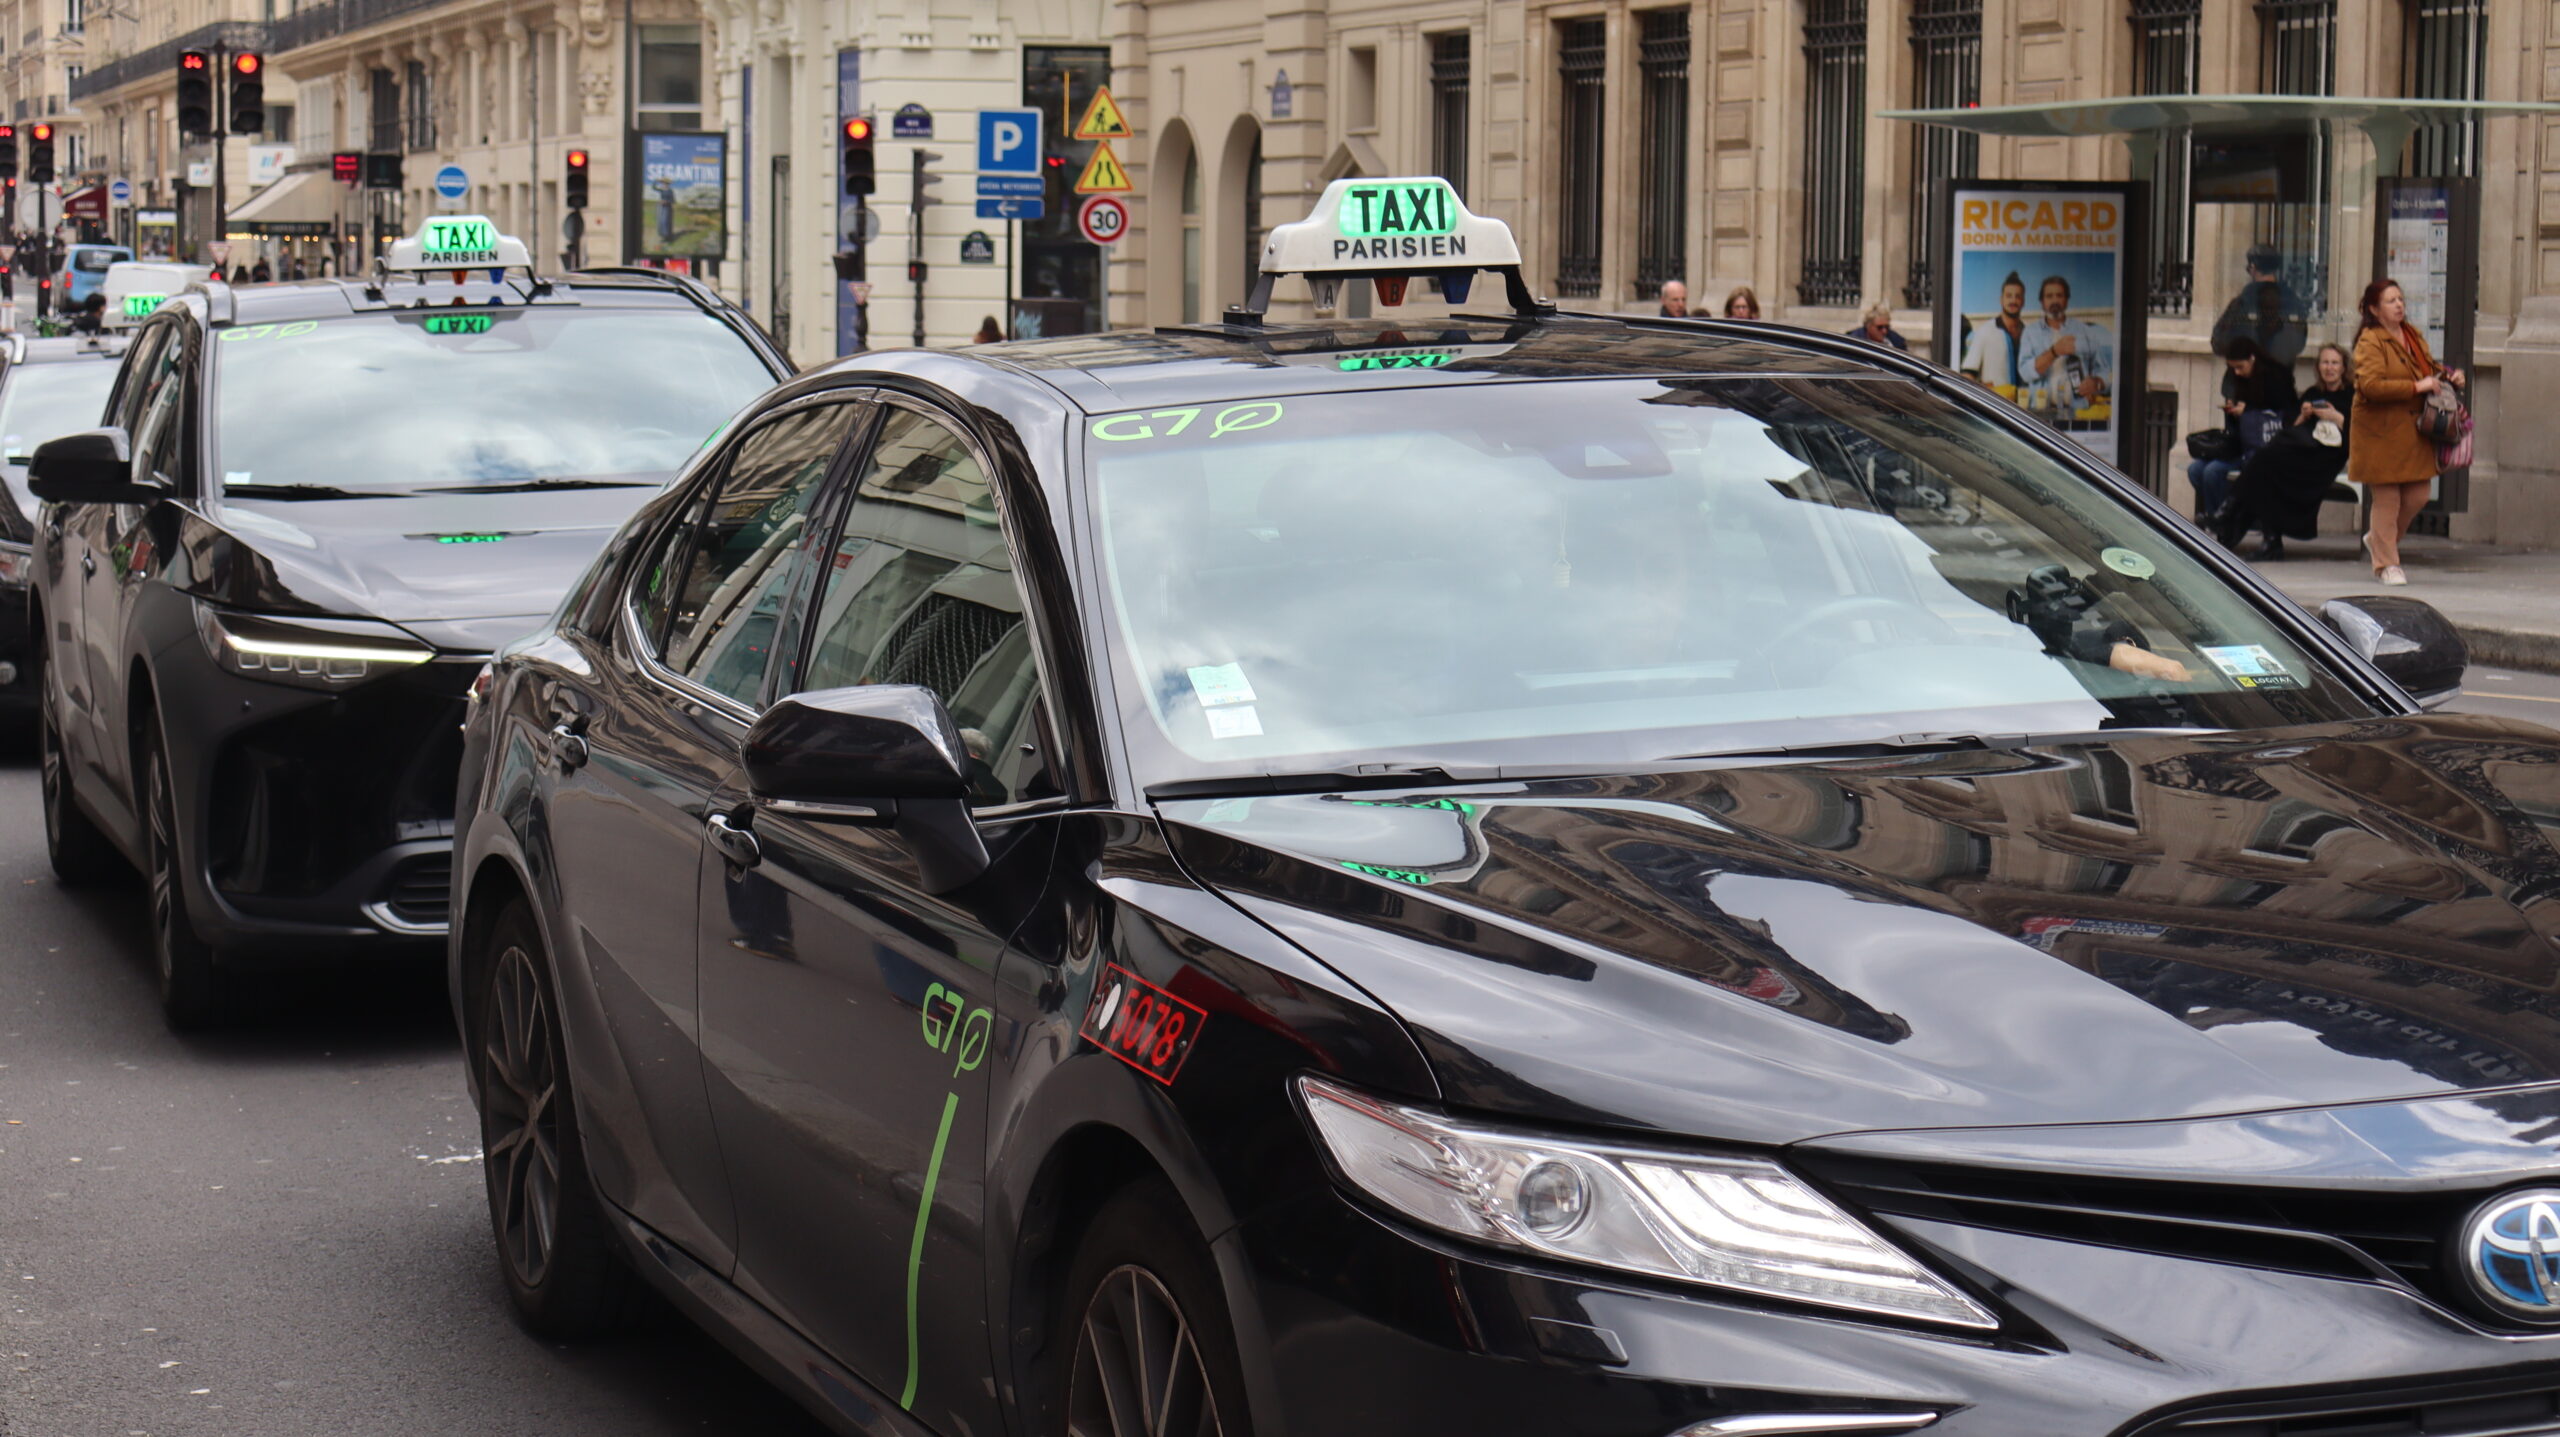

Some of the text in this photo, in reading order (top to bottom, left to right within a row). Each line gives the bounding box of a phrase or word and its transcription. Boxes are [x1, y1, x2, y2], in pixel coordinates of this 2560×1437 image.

[993, 121, 1023, 162] P
[647, 164, 720, 181] SEGANTINI
[1092, 210, 1118, 230] 30
[1352, 187, 1446, 233] TAXI
[1962, 200, 2117, 231] RICARD
[433, 224, 485, 249] TAXI
[1334, 235, 1467, 260] PARISIEN
[1962, 232, 2007, 246] BORN
[2026, 233, 2116, 248] MARSEILLE
[422, 251, 499, 263] PARISIEN
[1324, 284, 1334, 305] A
[1390, 284, 1400, 304] B
[218, 324, 276, 341] G7
[1091, 409, 1202, 442] G7
[922, 982, 965, 1054] G7
[1110, 987, 1185, 1067] 5078
